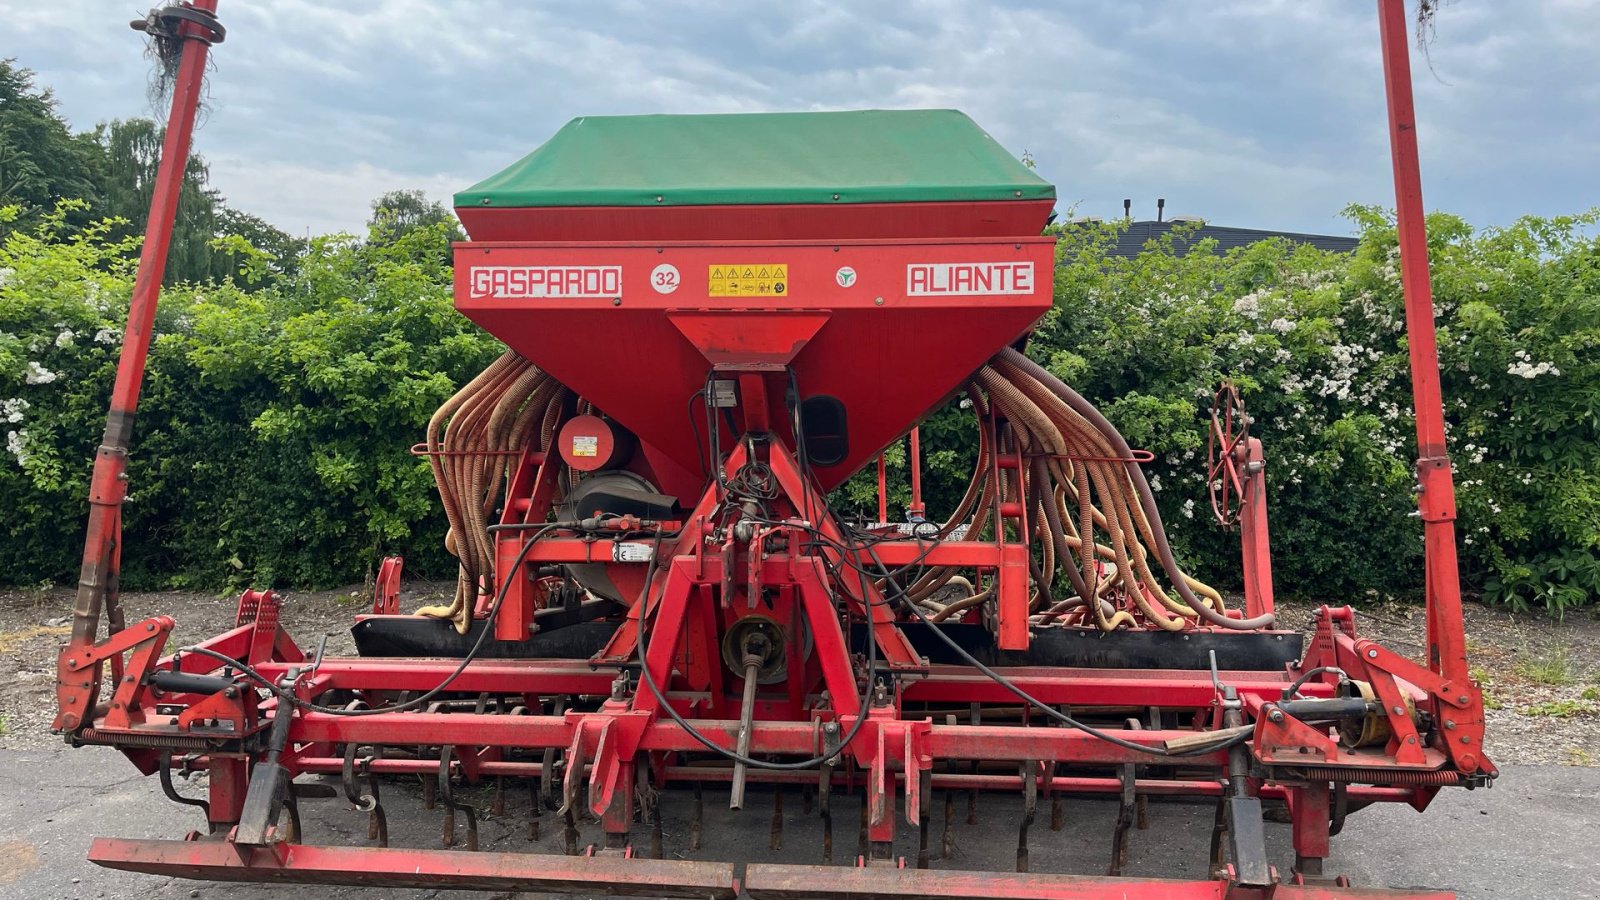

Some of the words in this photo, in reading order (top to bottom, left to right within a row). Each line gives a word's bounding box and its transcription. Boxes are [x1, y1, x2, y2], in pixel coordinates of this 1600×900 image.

[473, 269, 619, 295] GASPARDO
[655, 271, 675, 286] 32
[910, 264, 1030, 292] ALIANTE
